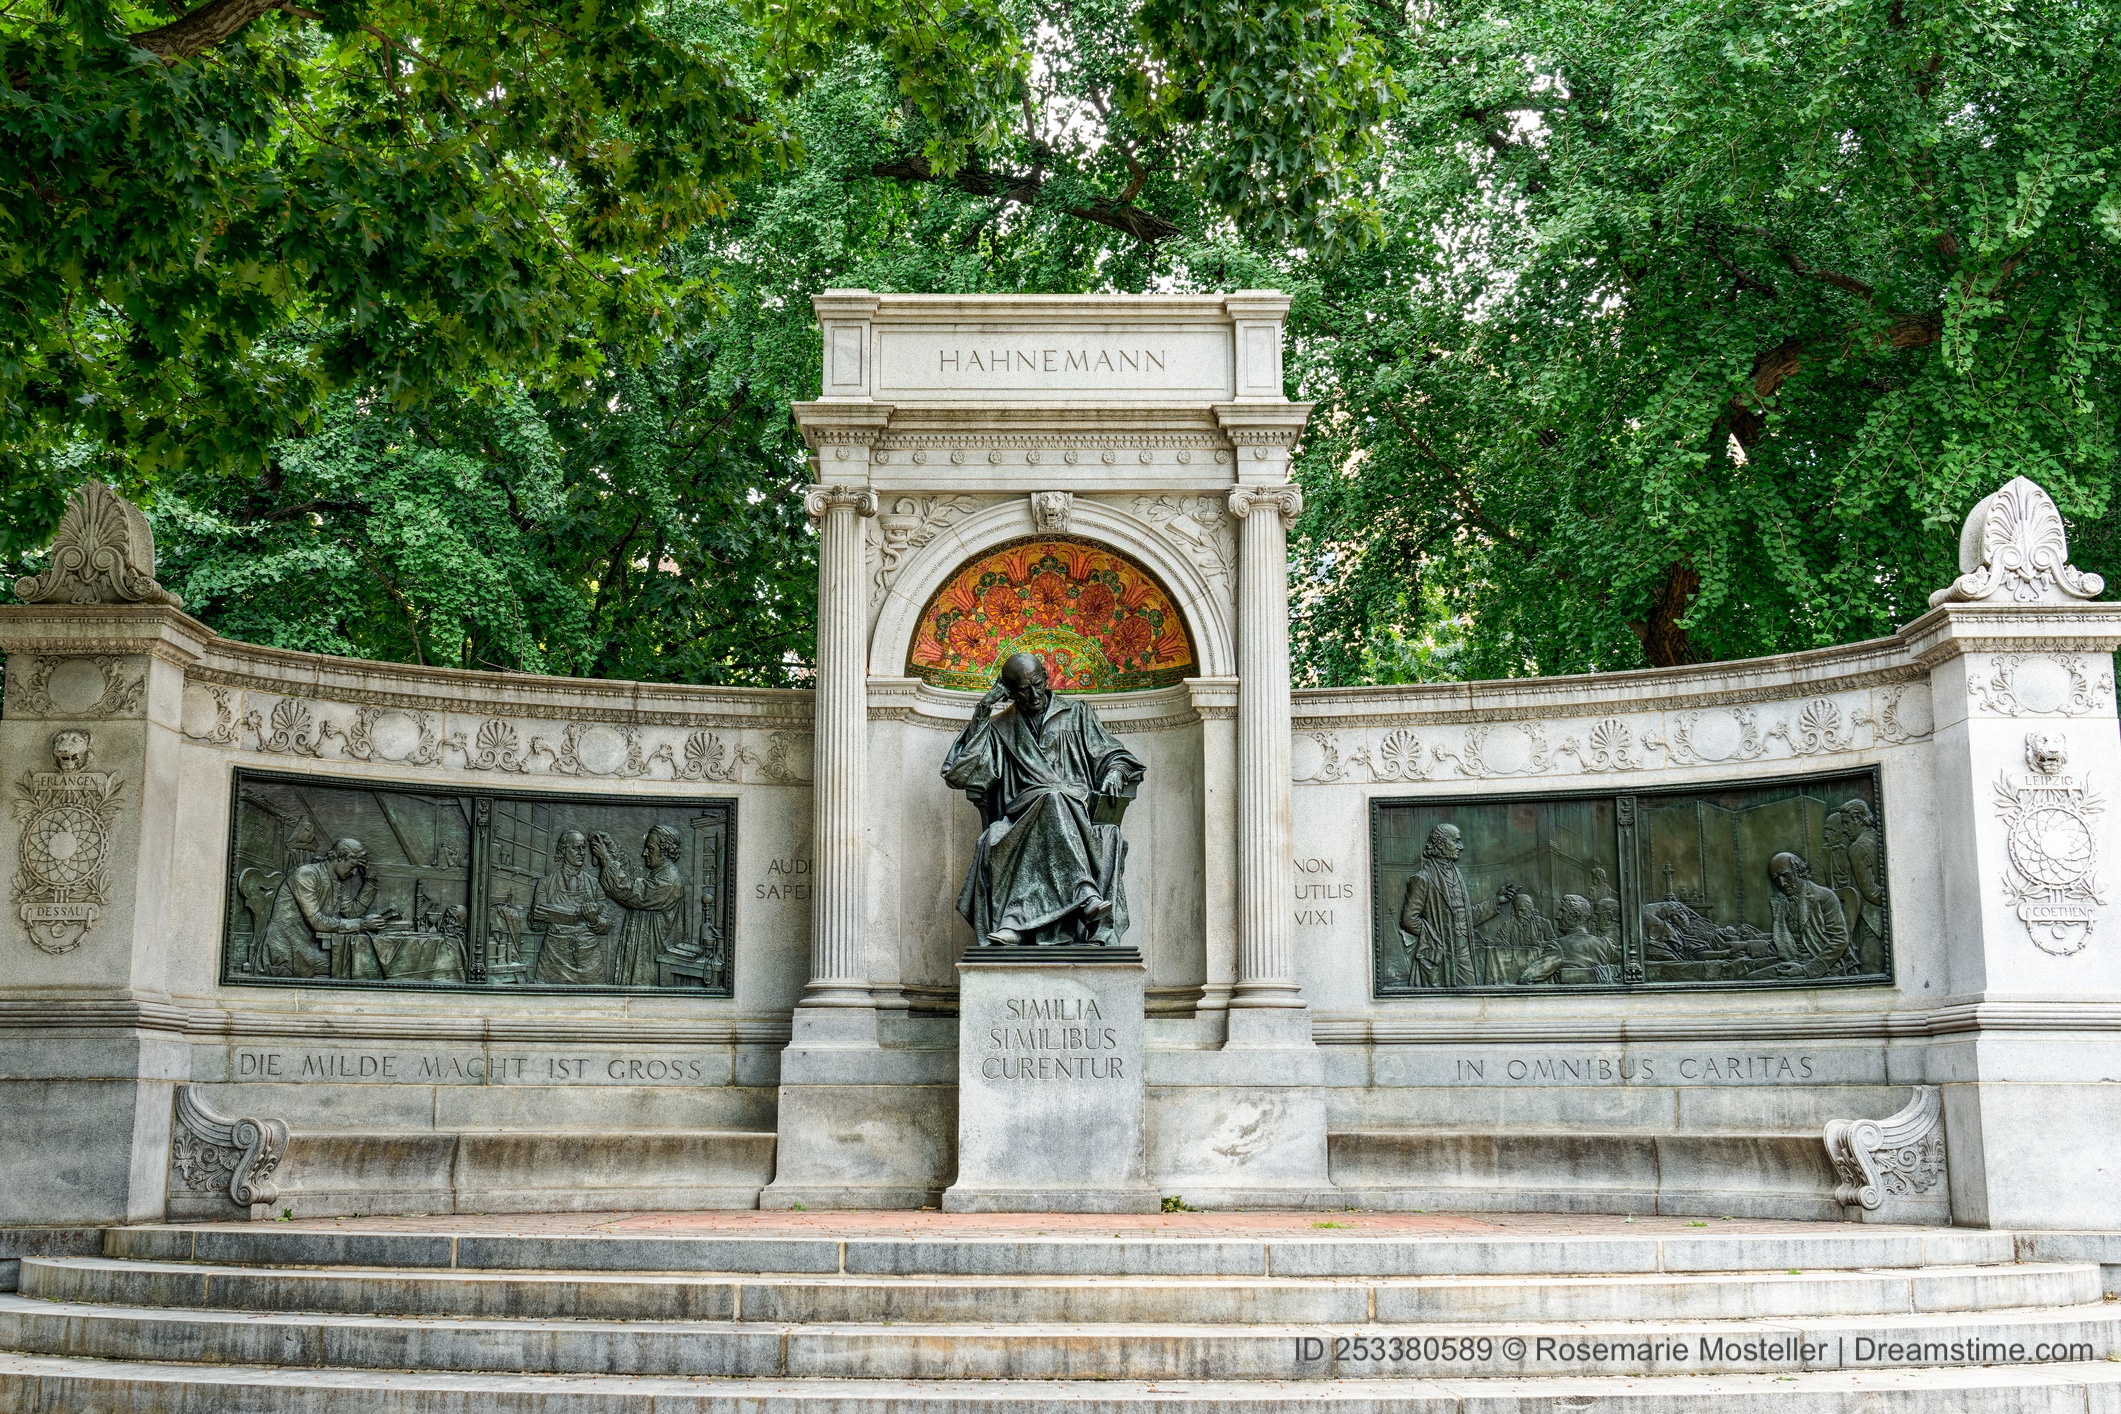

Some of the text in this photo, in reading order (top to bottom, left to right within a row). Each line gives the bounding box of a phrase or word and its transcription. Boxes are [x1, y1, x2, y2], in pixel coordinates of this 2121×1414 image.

[939, 349, 1166, 372] HAHNEMANN
[40, 775, 98, 787] ERLANGEN
[2025, 775, 2073, 786] LEIPZIG
[1293, 858, 1334, 874] NON
[1294, 883, 1354, 900] UTILIS
[37, 906, 83, 917] DESSAU
[1294, 909, 1334, 926] VIXI
[2032, 906, 2087, 918] COETHEN
[1005, 998, 1102, 1021] SIMILIA
[988, 1027, 1117, 1050] SIMILIBUS
[240, 1053, 702, 1081] DIE MILDE MACHT IST GROSS
[981, 1056, 1125, 1080] CURENTUR
[1456, 1056, 1814, 1081] IN OMNIBUS CARITAS
